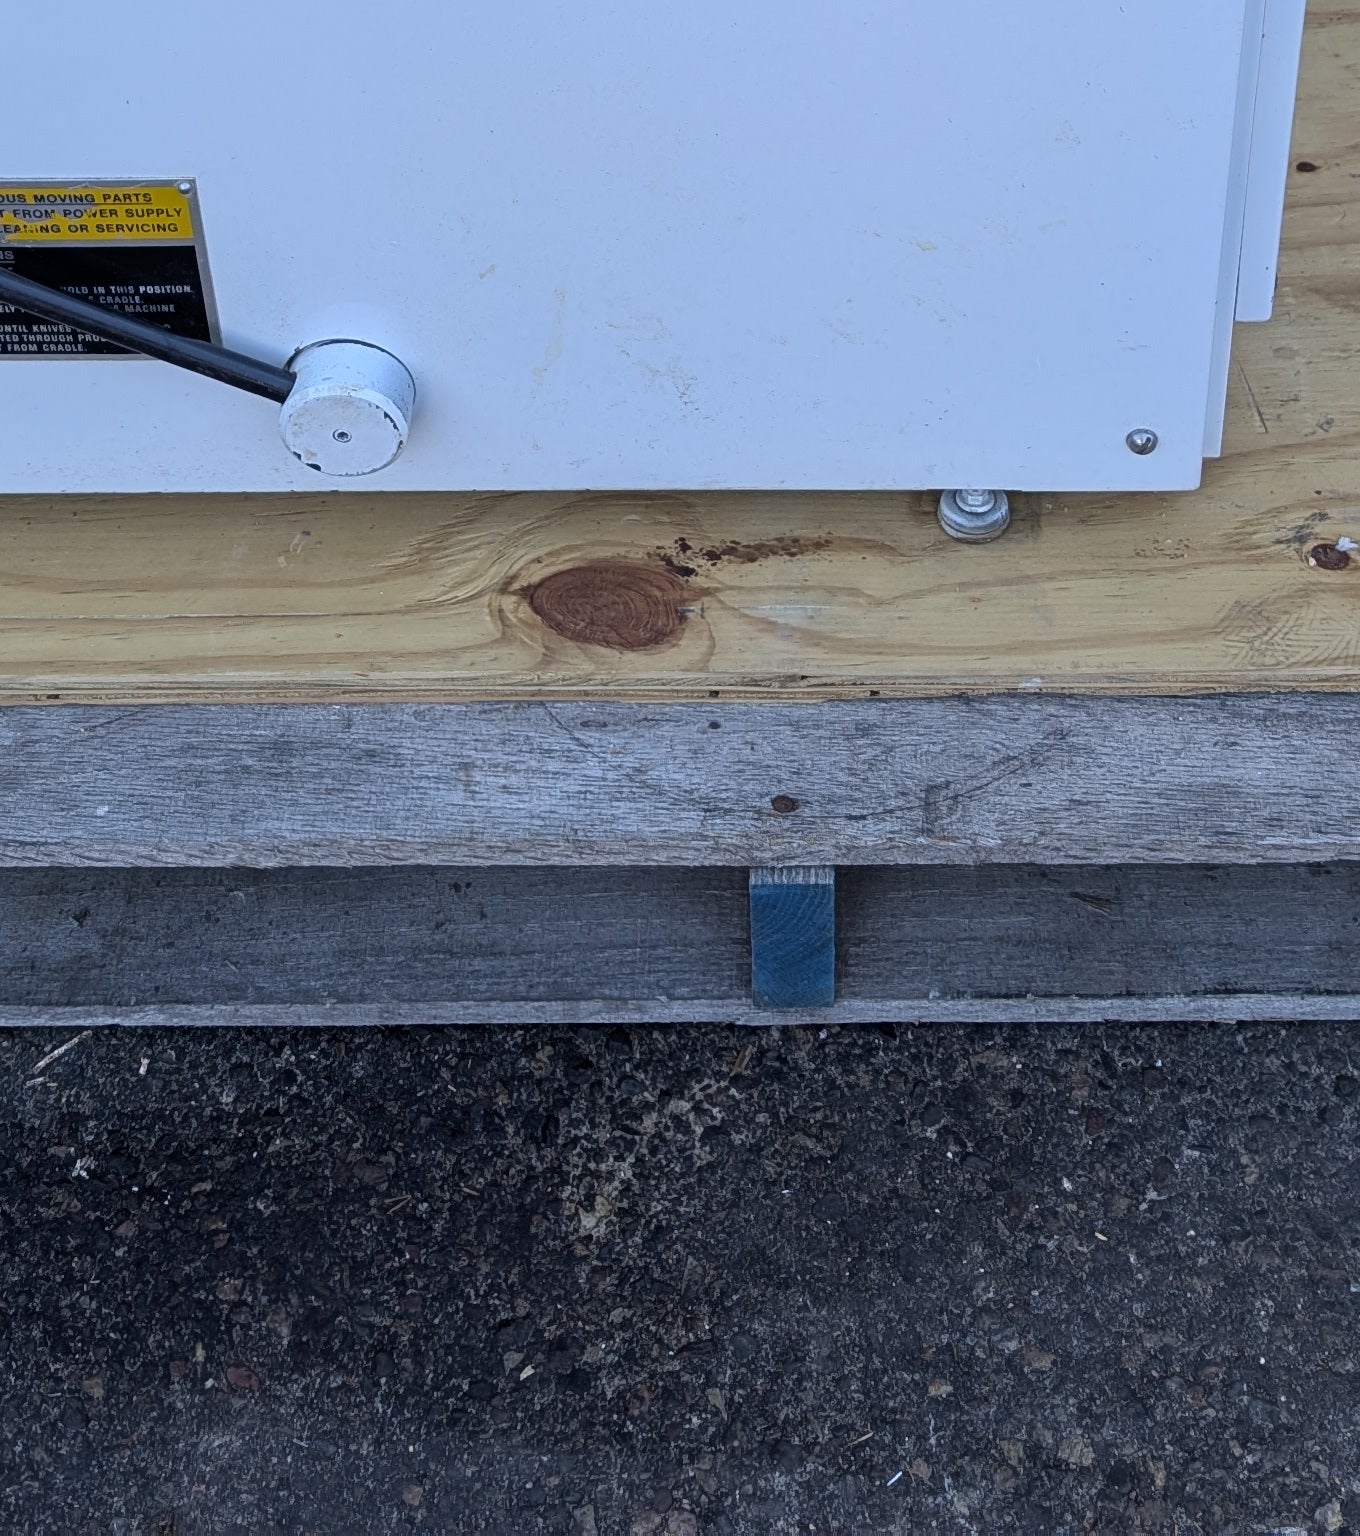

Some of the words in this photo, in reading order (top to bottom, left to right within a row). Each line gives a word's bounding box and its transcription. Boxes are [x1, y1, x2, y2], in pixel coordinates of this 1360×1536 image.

[33, 193, 96, 204] MOVING
[102, 193, 153, 204] PARTS
[13, 208, 56, 220] FROM
[63, 208, 119, 220] POWER
[125, 208, 183, 220] SUPPLY
[67, 223, 90, 234] OR
[95, 223, 179, 234] SERVICING
[94, 286, 106, 295] IN
[110, 286, 135, 295] THIS
[125, 305, 176, 314] MACHINE
[32, 324, 72, 333] KNIVES
[22, 334, 74, 342] THROUGH
[7, 343, 39, 352] FROM
